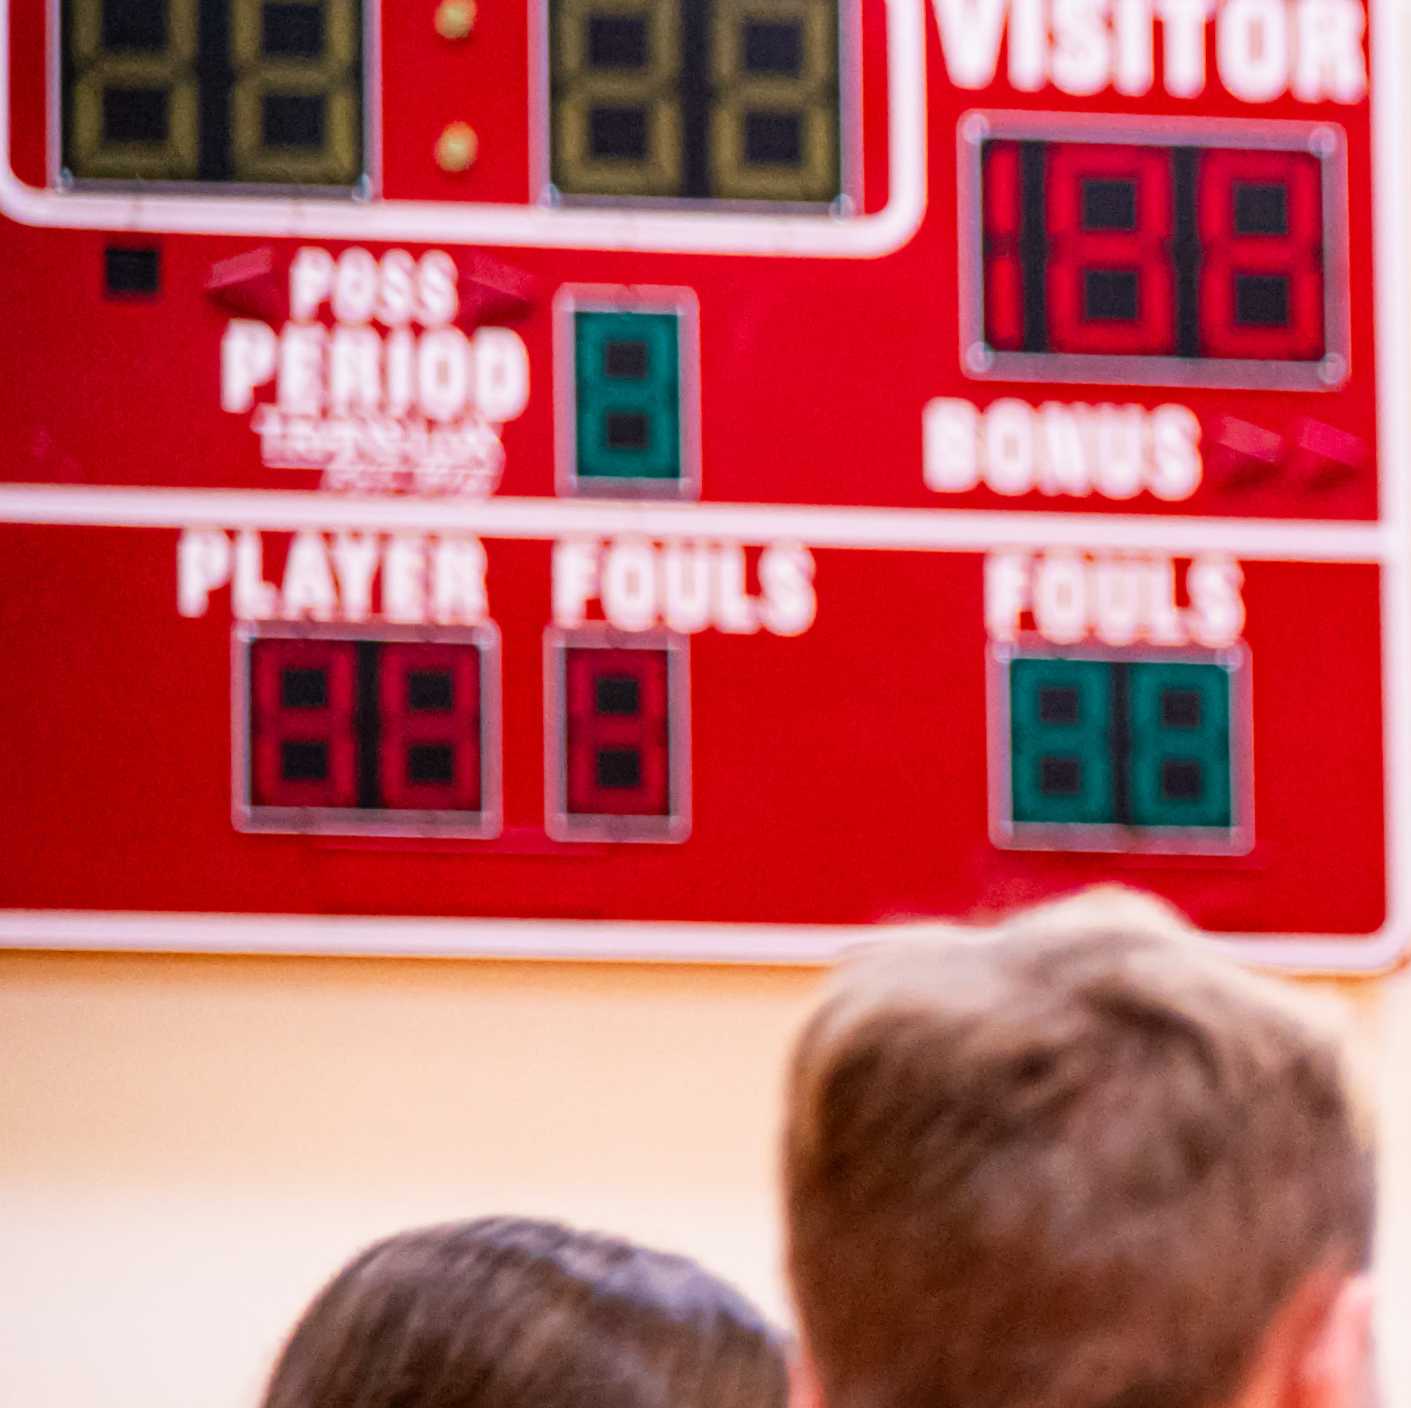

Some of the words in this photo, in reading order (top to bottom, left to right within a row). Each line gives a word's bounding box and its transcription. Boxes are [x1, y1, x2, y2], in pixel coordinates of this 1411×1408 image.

[932, 0, 1369, 104] VISITOR
[289, 247, 459, 326] POSS
[220, 318, 530, 423] PERIOD
[922, 396, 1203, 500] BONUS
[177, 529, 489, 624] PLAYER
[550, 541, 816, 636] FOULS
[984, 548, 1246, 648] FOULS
